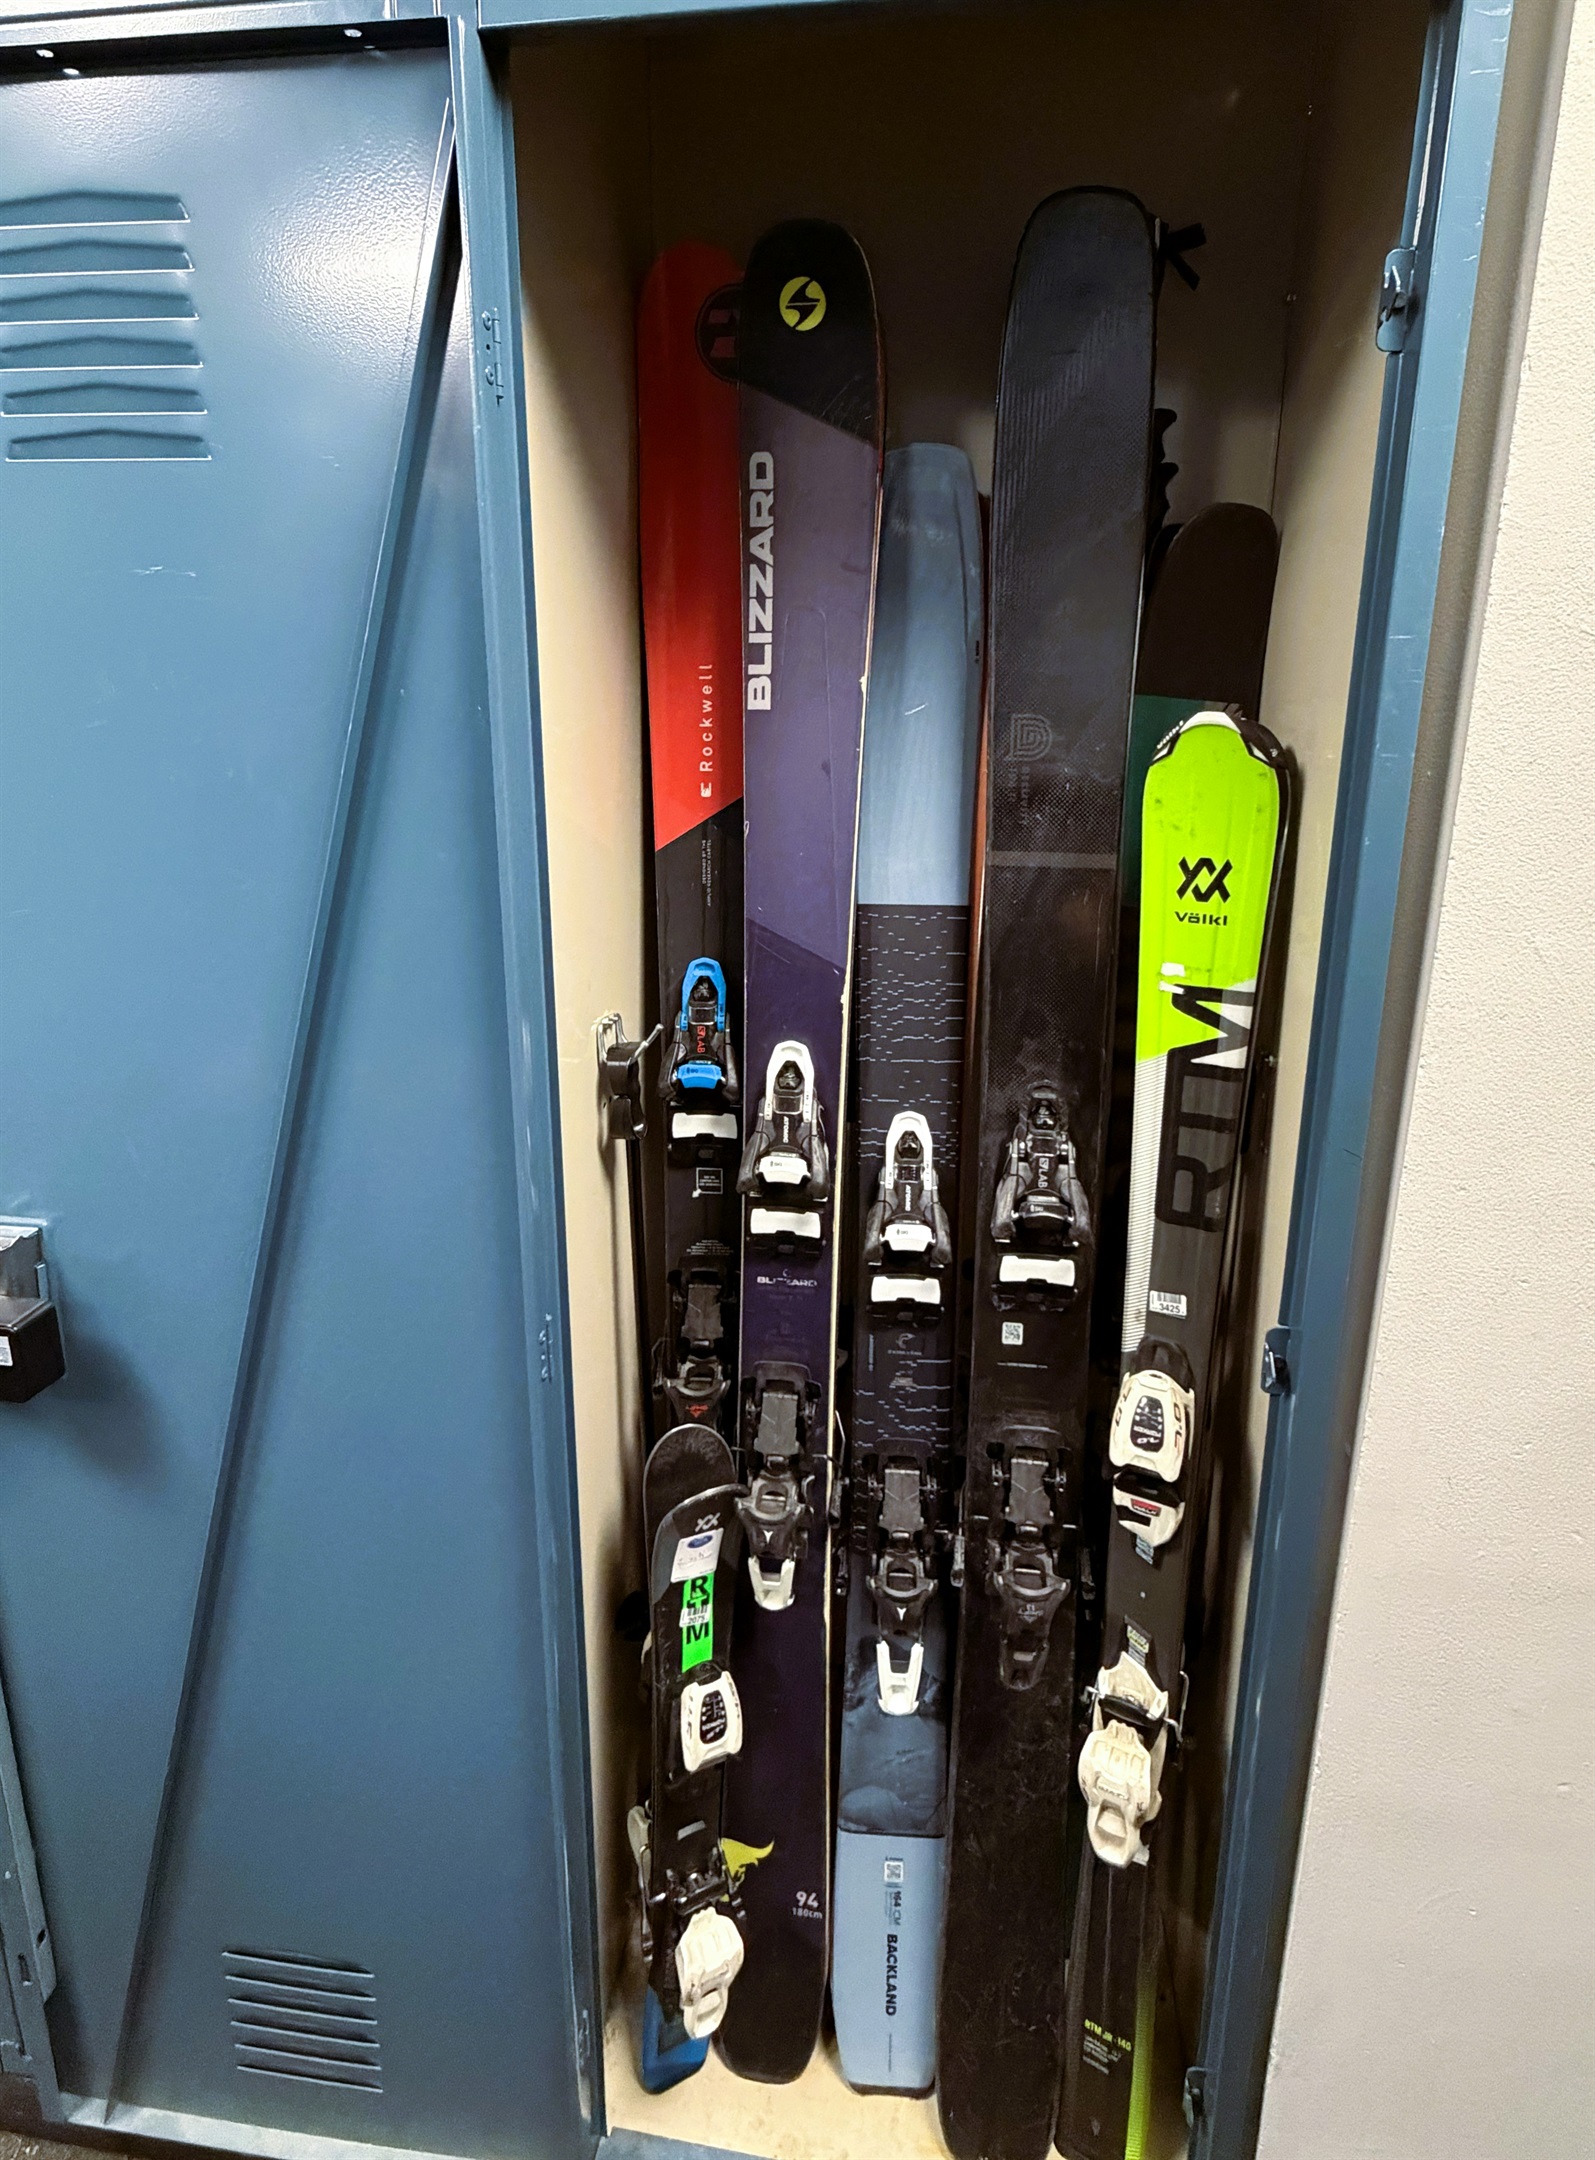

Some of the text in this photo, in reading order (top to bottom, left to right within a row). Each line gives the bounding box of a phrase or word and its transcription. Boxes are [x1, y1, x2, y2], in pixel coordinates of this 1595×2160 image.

[747, 451, 775, 711] BLIZZARD
[698, 664, 713, 772] Rockwell
[1174, 911, 1228, 926] Völkl
[1159, 1303, 1181, 1314] 3425
[795, 1890, 819, 1908] 94
[792, 1907, 823, 1920] 180cm
[885, 1933, 898, 2017] BACKLAND
[1084, 2018, 1102, 2036] RTM
